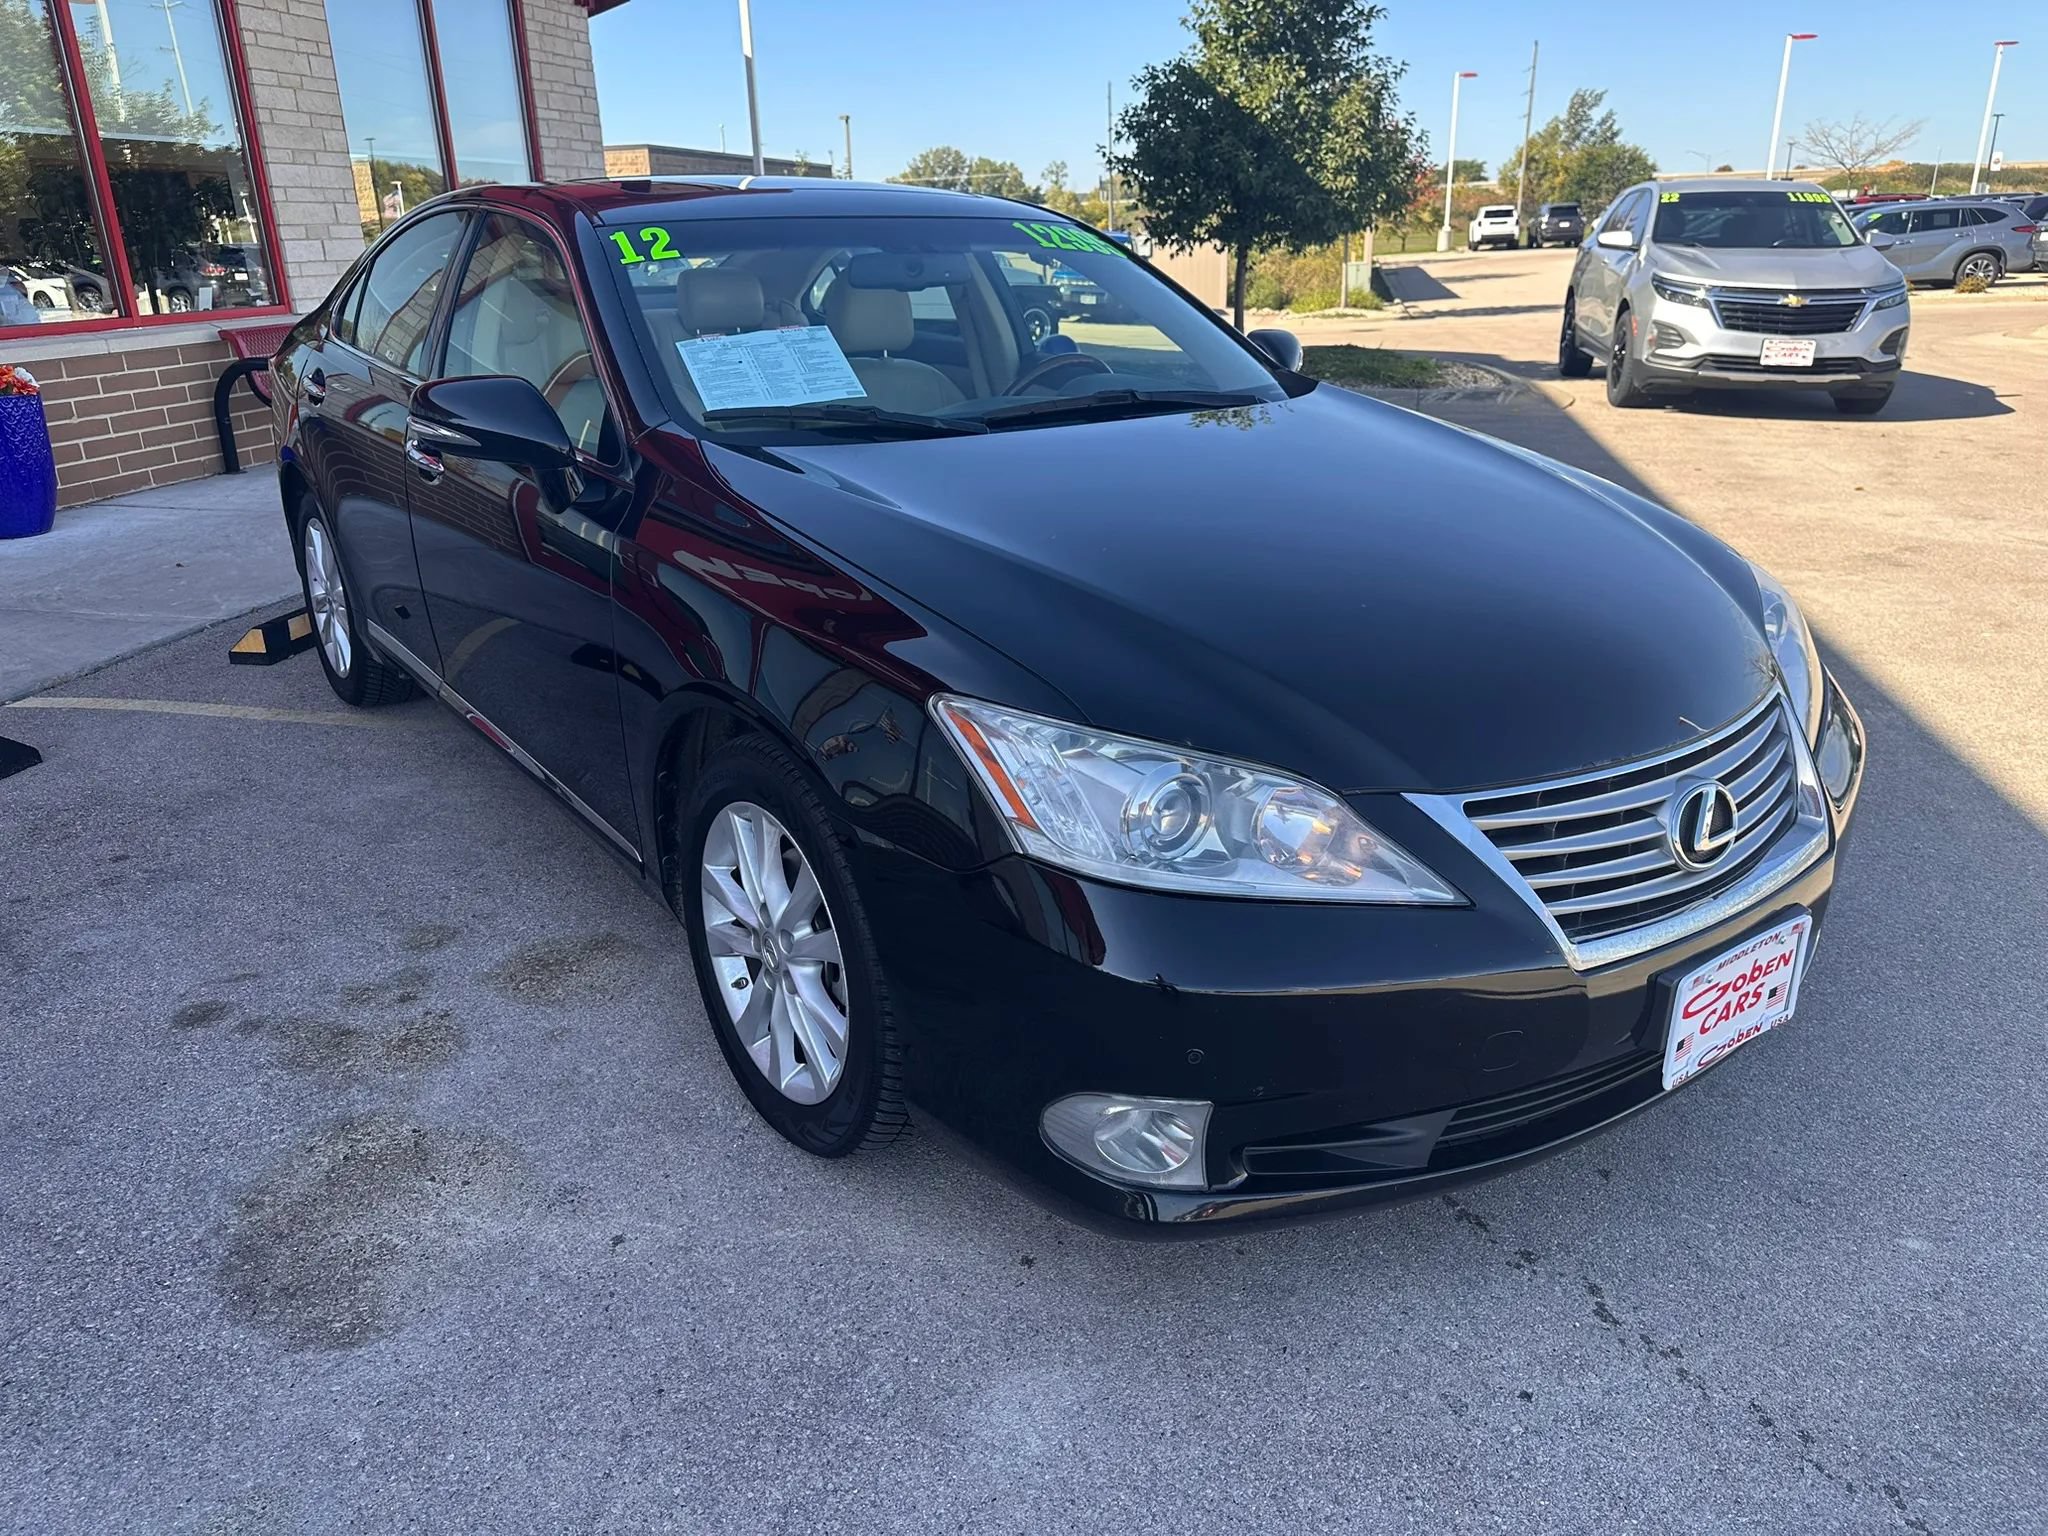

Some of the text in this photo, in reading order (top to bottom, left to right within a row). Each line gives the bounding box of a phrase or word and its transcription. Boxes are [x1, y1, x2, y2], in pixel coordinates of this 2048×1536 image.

[608, 226, 681, 265] 12
[1716, 931, 1781, 972] MIDDLETON
[1699, 982, 1766, 1035] CARS
[1770, 1014, 1791, 1028] USA
[1671, 1070, 1690, 1088] USA
